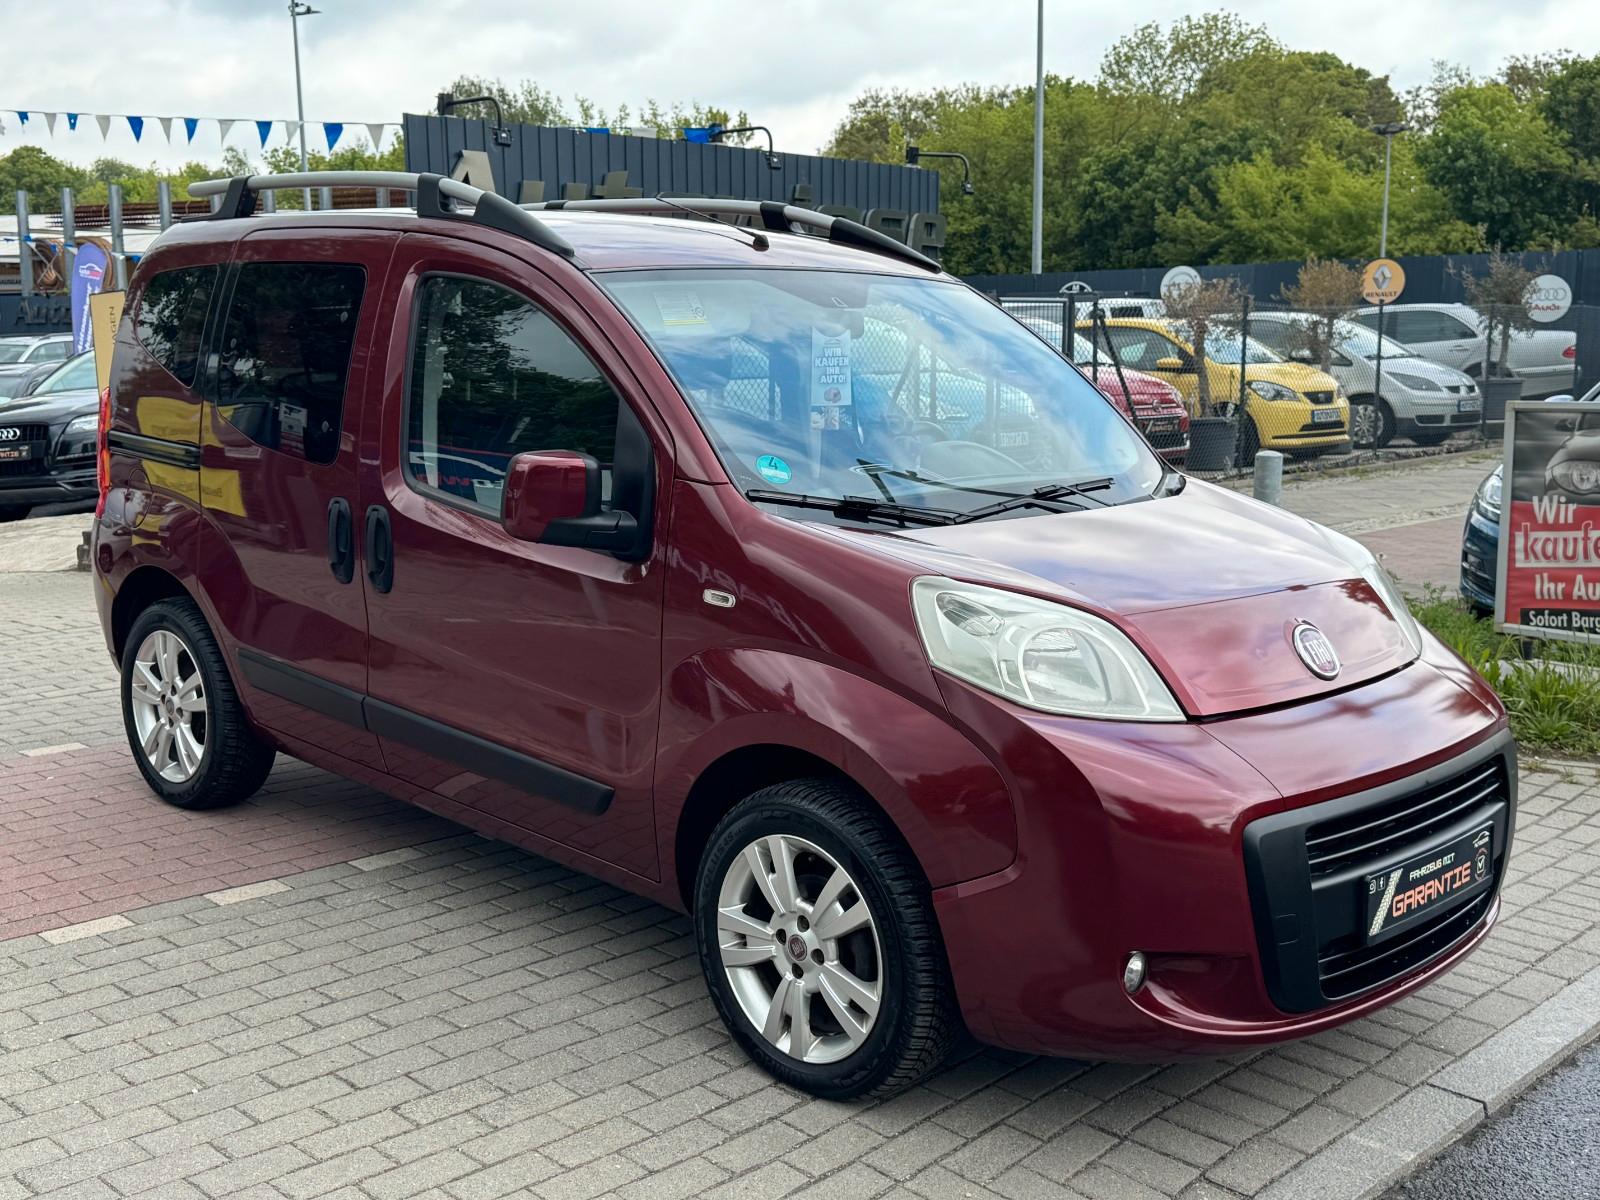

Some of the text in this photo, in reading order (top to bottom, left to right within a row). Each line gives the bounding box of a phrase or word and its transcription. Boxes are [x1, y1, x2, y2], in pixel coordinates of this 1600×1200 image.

[1365, 290, 1397, 298] RENAULT
[823, 347, 842, 357] WIR
[814, 357, 849, 367] KAUFEN
[826, 366, 841, 375] IHR
[768, 456, 778, 470] 4
[1531, 495, 1577, 524] Wir
[1534, 572, 1566, 600] Ihr
[1528, 609, 1568, 627] Sofort
[1409, 858, 1443, 882] FAHRZEUG
[1392, 861, 1472, 917] GARANTIE
